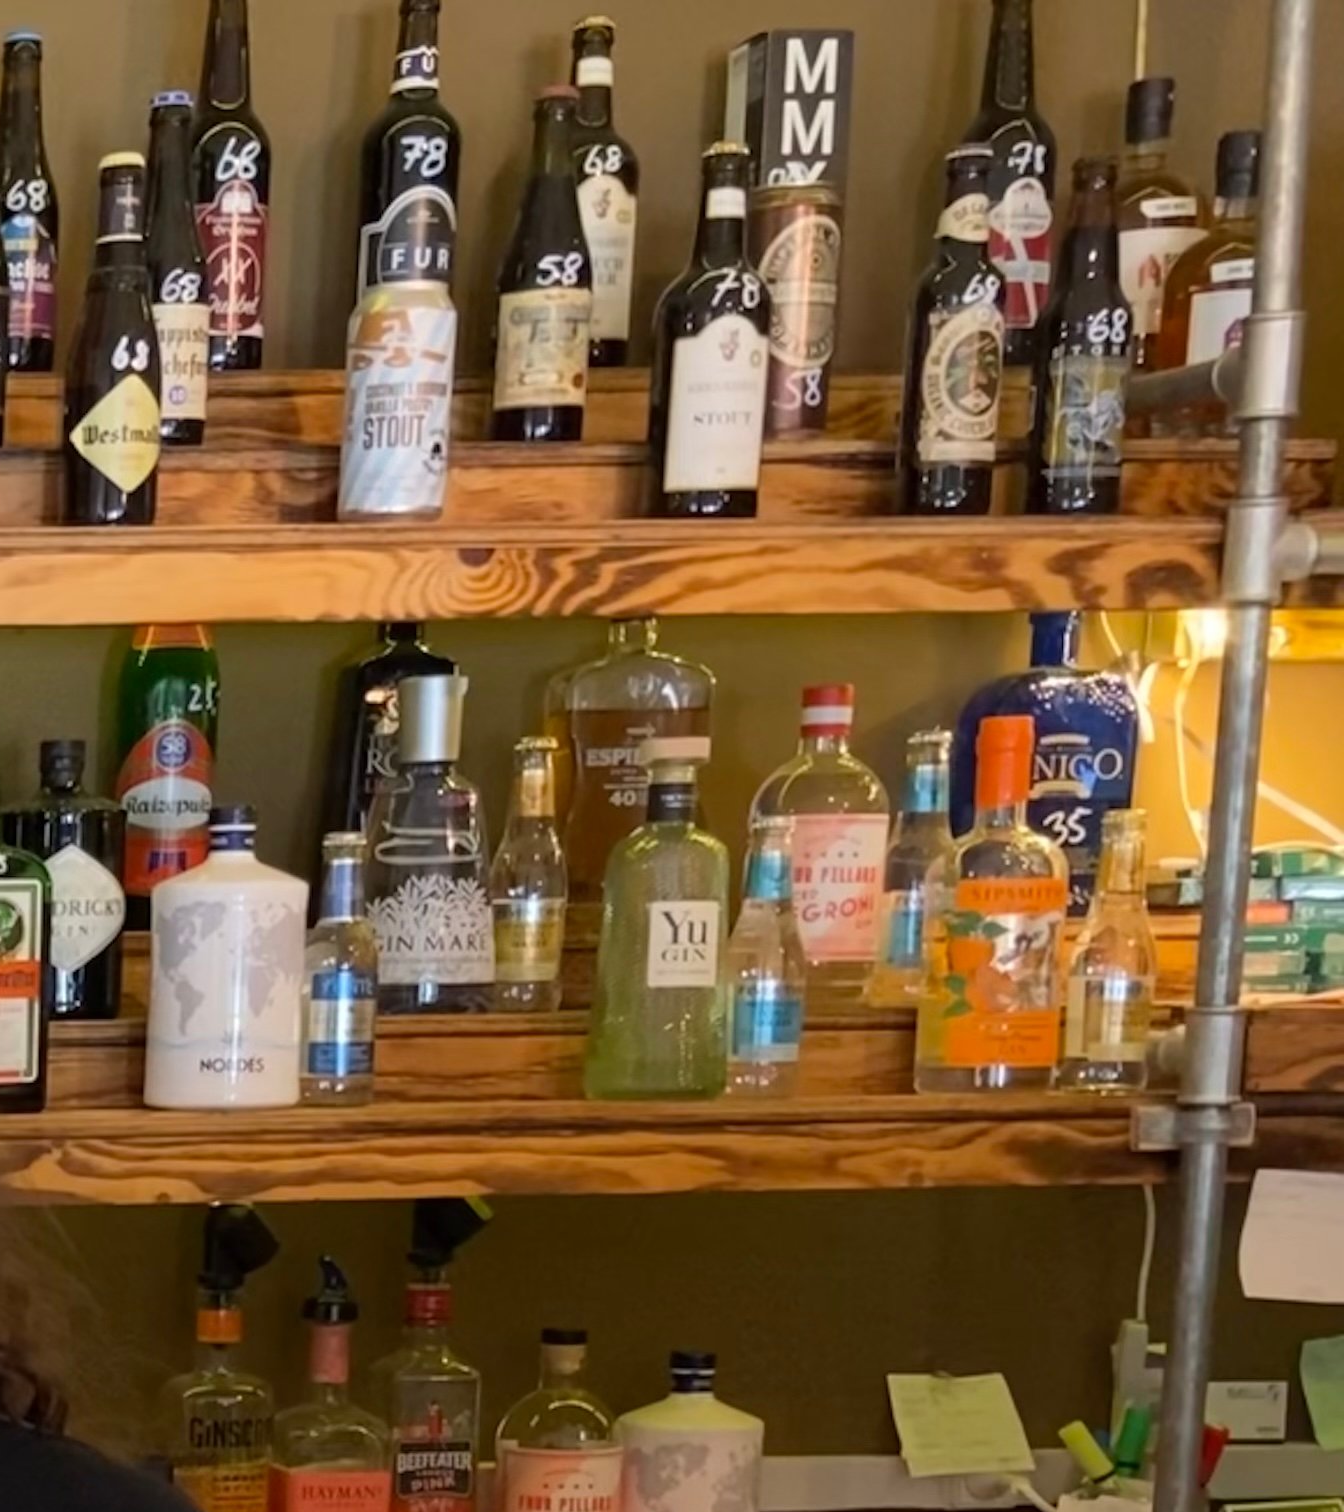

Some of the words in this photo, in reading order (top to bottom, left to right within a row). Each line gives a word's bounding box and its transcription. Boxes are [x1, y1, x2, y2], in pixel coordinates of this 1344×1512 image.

[215, 136, 261, 182] 68
[400, 135, 448, 178] 78
[583, 145, 623, 176] 68
[6, 178, 48, 213] 68
[391, 246, 449, 271] FUR
[536, 253, 584, 287] 58
[160, 268, 201, 303] 68
[711, 266, 761, 308] 78
[1086, 308, 1128, 343] 68
[363, 415, 426, 450] STOUT
[1042, 806, 1093, 849] 35
[661, 909, 707, 945] Yu
[660, 947, 705, 963] GIN
[397, 1450, 472, 1473] BEEFEATER
